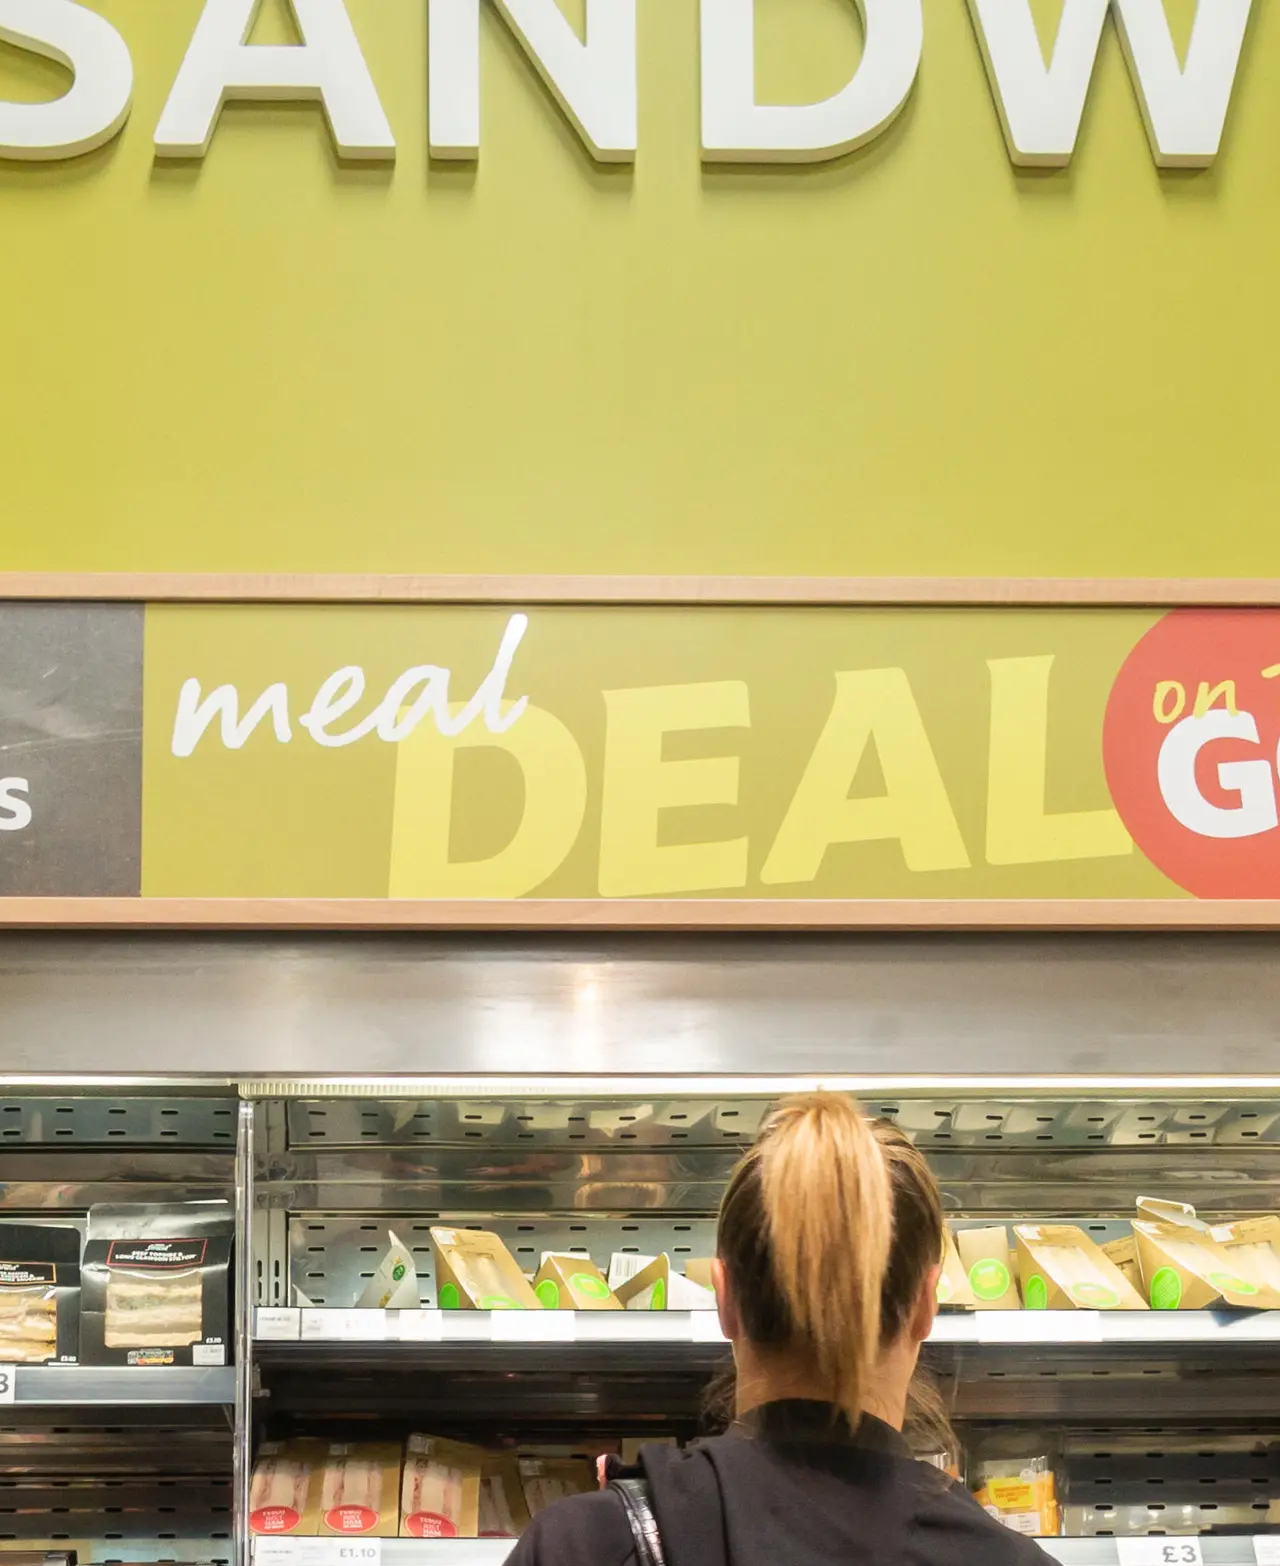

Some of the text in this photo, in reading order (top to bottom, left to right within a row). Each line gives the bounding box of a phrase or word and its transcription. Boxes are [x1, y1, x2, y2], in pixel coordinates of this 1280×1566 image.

[169, 613, 528, 758] meal
[1152, 674, 1240, 725] on
[387, 653, 1133, 898] DEAL
[340, 1548, 377, 1559] £1.10
[1162, 1546, 1197, 1563] £3
